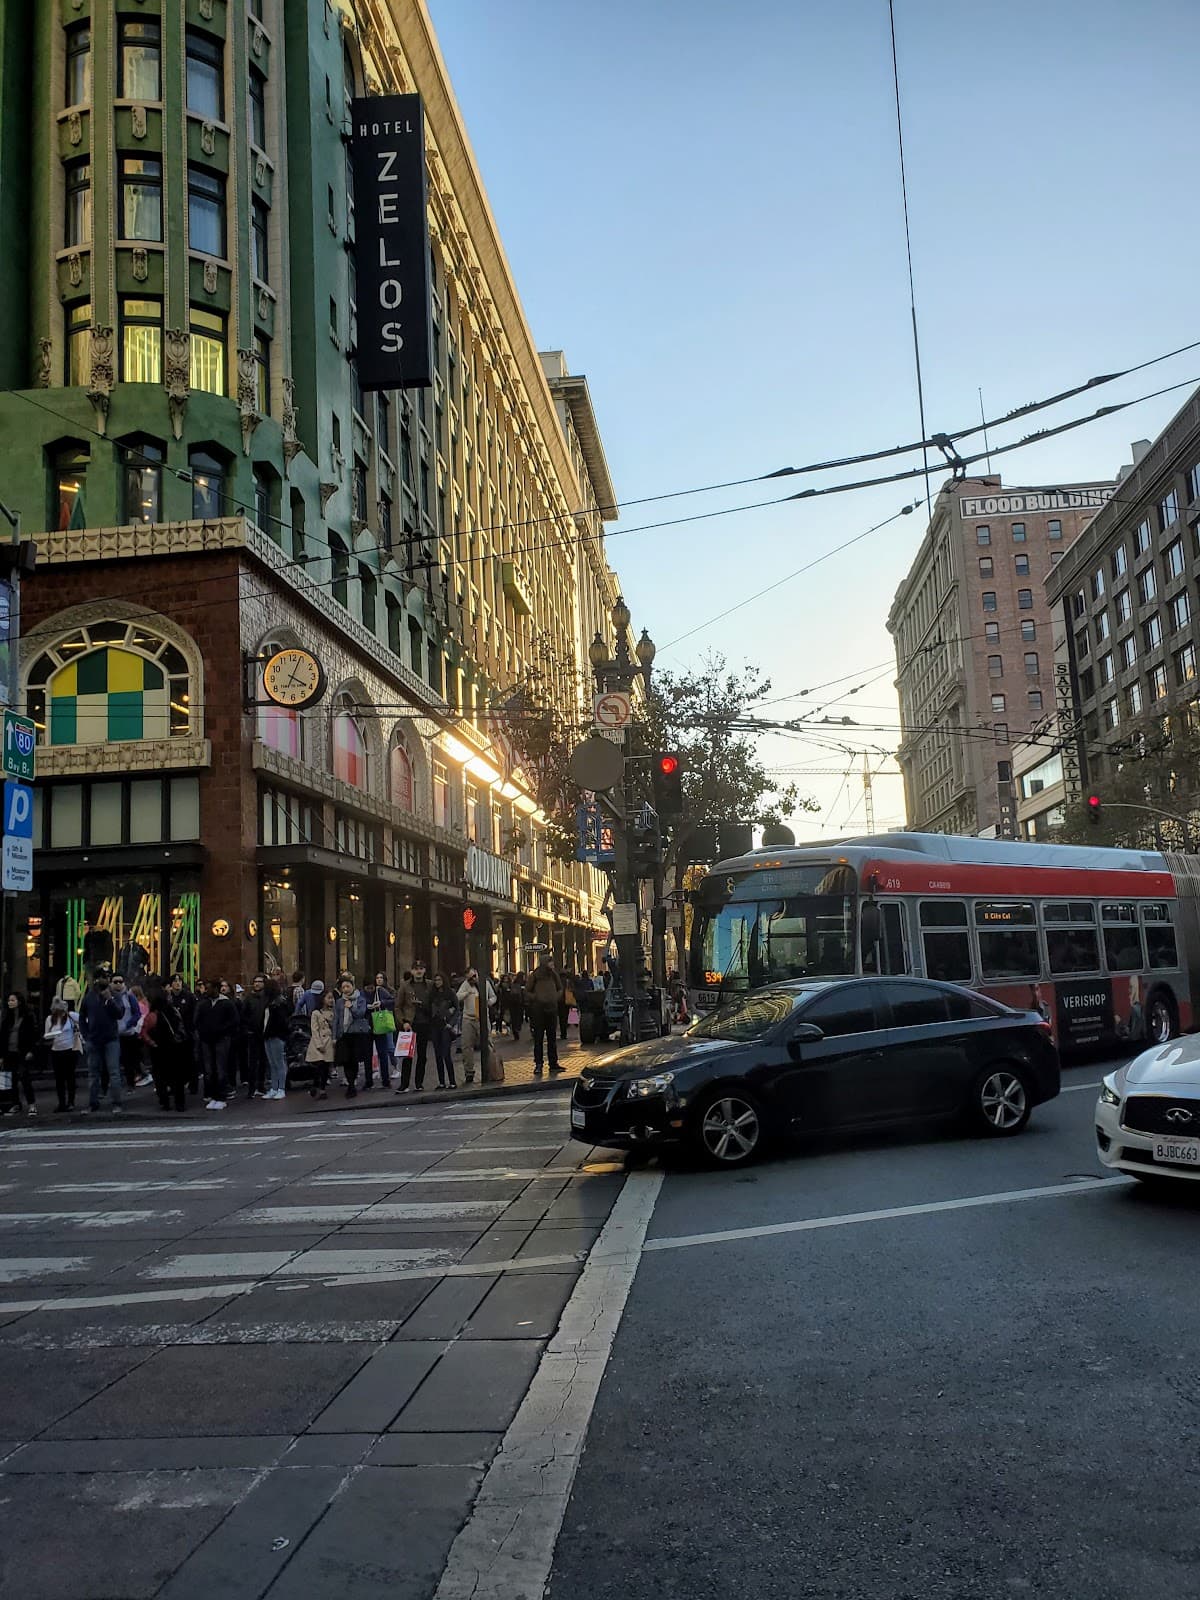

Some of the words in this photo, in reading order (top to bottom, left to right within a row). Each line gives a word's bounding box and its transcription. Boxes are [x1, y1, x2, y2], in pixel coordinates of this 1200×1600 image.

[359, 120, 413, 137] HOTEL
[376, 151, 404, 353] ZELOS
[965, 496, 1024, 516] FLOOD
[280, 657, 286, 665] 11
[289, 654, 297, 662] 12
[272, 665, 281, 673] 10
[308, 663, 313, 671] 2
[270, 675, 275, 683] 9
[311, 673, 316, 681] 3
[273, 685, 278, 693] 8
[280, 691, 286, 699] 7
[290, 693, 296, 701] 6
[300, 690, 306, 698] 5
[18, 735, 31, 751] 80
[8, 757, 19, 772] Bay
[22, 760, 30, 775] Br
[470, 846, 489, 889] OLD
[1063, 993, 1107, 1008] VERISHOP
[1157, 1144, 1198, 1160] 8JBC663
